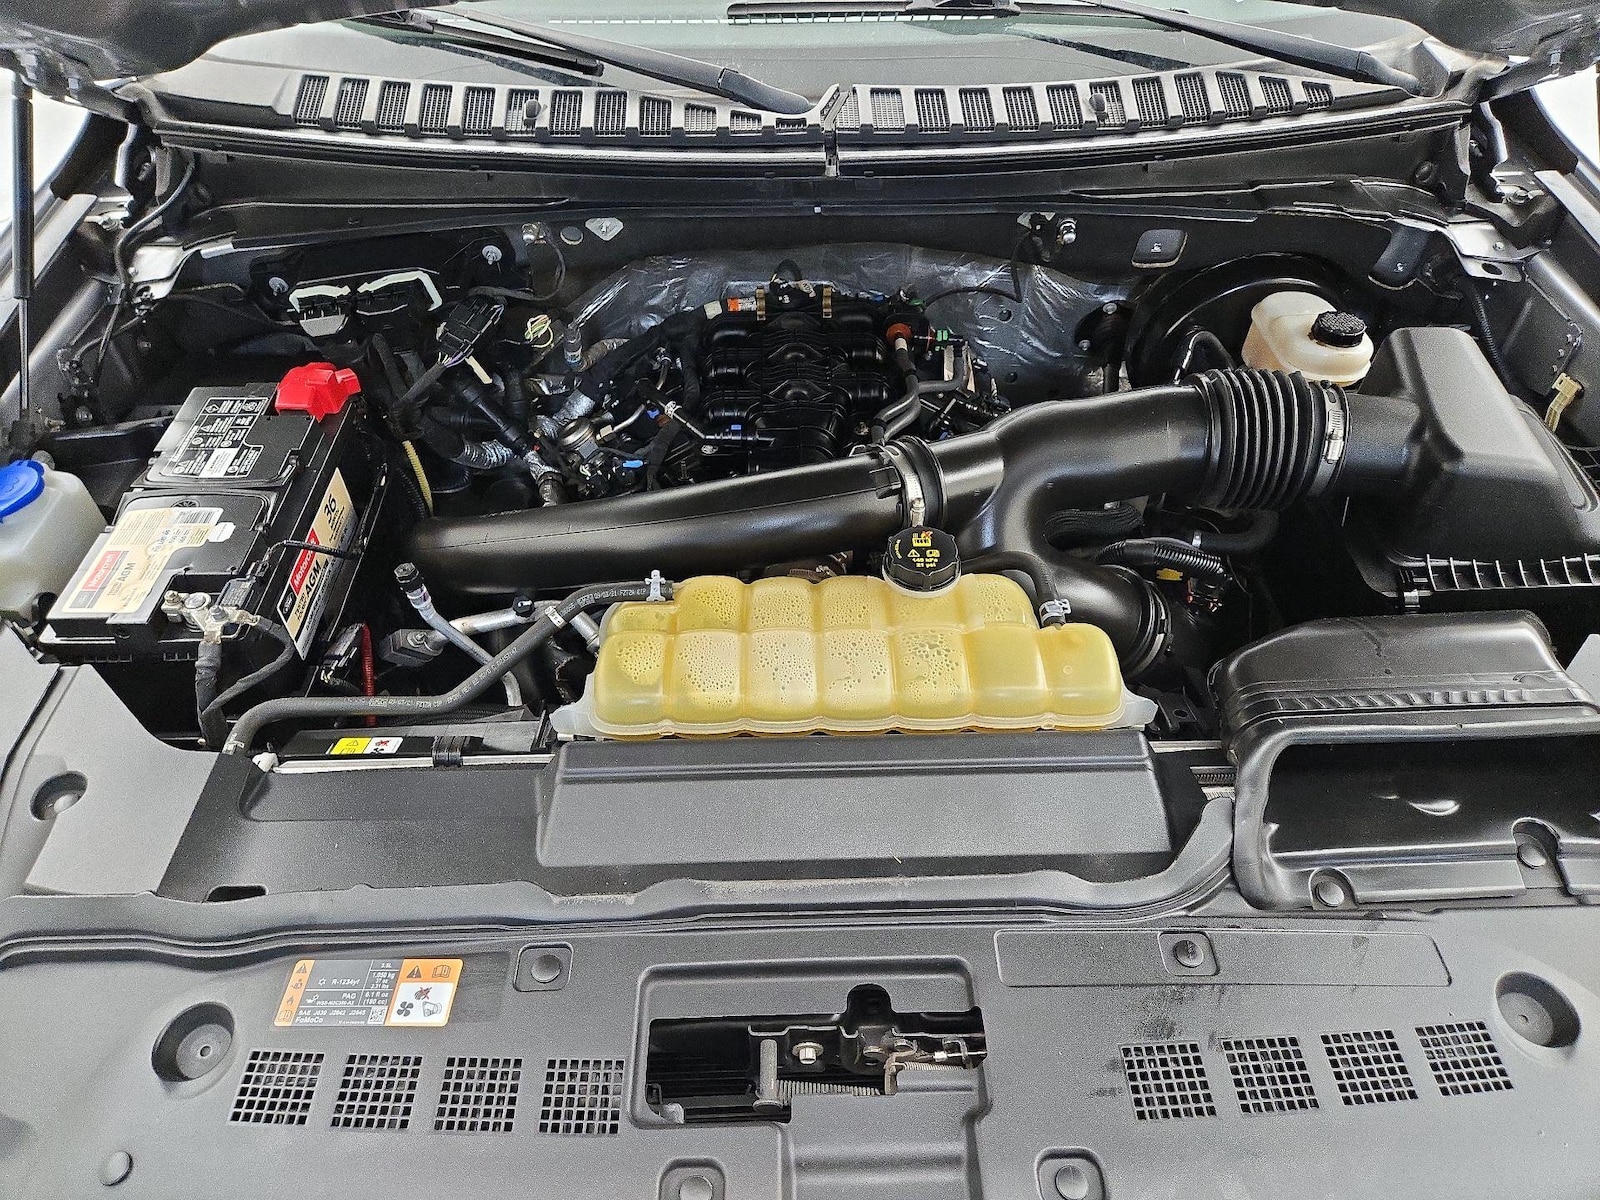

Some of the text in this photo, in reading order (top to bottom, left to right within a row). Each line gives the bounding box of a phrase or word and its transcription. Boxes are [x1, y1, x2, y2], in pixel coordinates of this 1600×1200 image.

[324, 493, 337, 524] 36
[117, 562, 136, 582] AGM
[305, 559, 322, 597] AGM
[331, 978, 361, 987] R-1234yf
[387, 971, 396, 980] kg
[295, 1016, 324, 1024] FoMoCo
